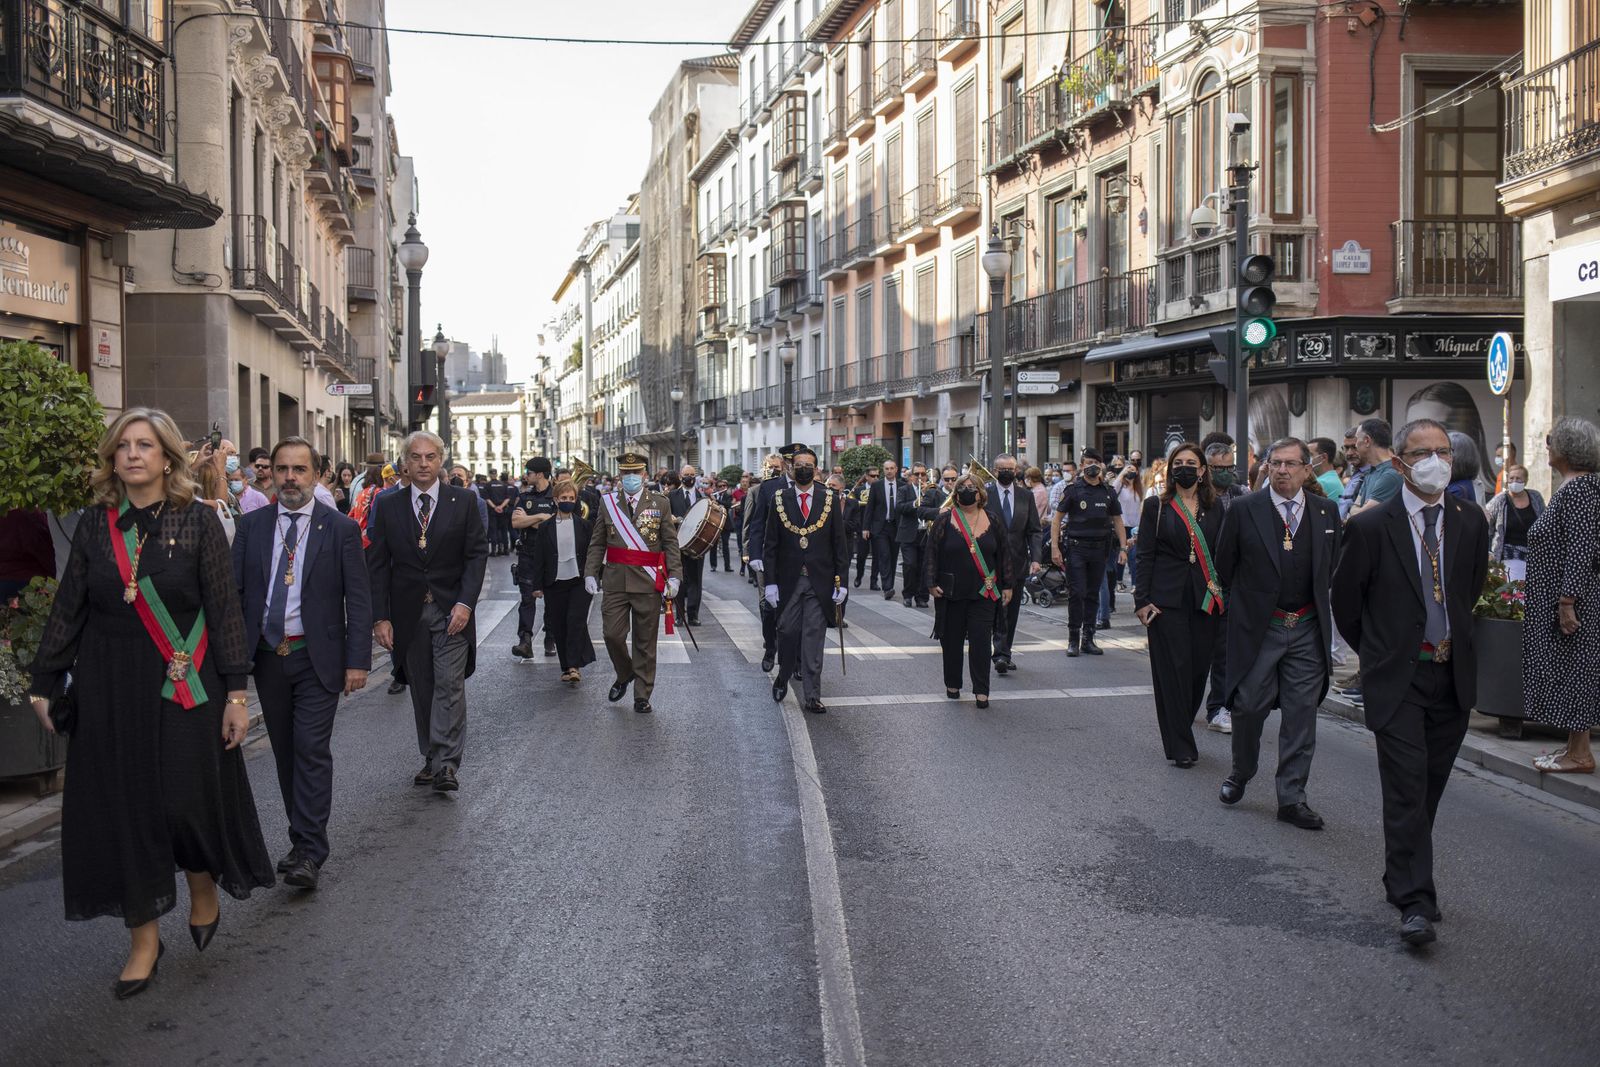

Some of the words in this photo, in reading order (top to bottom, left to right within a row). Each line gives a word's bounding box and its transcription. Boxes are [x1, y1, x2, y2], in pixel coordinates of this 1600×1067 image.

[1578, 260, 1599, 282] ca
[1306, 340, 1323, 355] 29
[1434, 335, 1483, 358] Miguel
